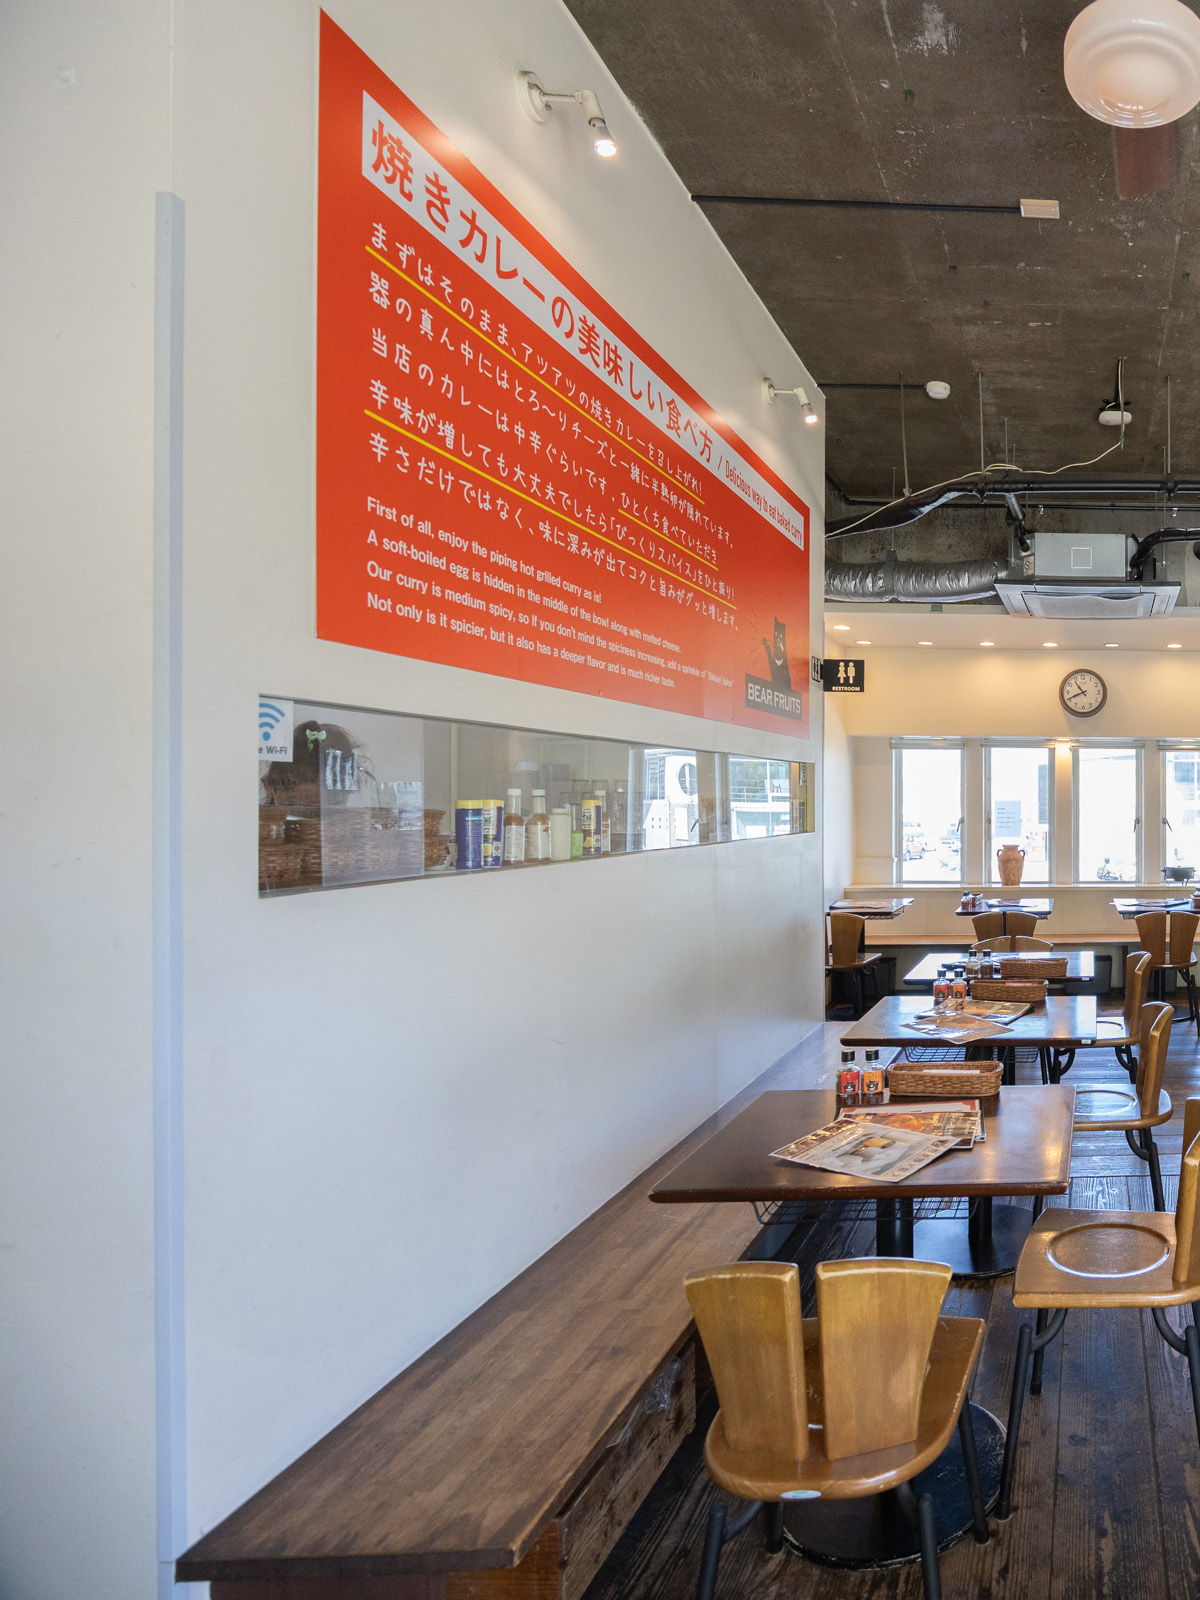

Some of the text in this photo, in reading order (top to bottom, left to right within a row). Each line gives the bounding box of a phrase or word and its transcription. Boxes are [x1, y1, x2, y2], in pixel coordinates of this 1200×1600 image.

[371, 117, 713, 464] 焼きカレーの美味しい食べ方
[725, 459, 751, 499] Delicious
[751, 488, 764, 512] way
[763, 495, 769, 513] to
[768, 505, 777, 520] eat
[776, 506, 791, 532] baked
[791, 524, 803, 547] curry
[367, 496, 602, 604] First of all, enjoy the piping hot grilled curry as is!
[367, 529, 681, 654] A soft-boiled egg is hidden in the middle of the bowl along with melted cheese.
[367, 560, 393, 582] Our
[396, 571, 429, 596] curry
[432, 581, 442, 598] is
[445, 586, 486, 612] medium
[489, 602, 516, 623] spicy,
[518, 612, 530, 625] so
[531, 614, 538, 628] If
[539, 617, 556, 633] you
[557, 621, 577, 640] don't
[577, 630, 595, 646] mind
[596, 635, 607, 649] the
[608, 640, 637, 658] spiciness
[637, 648, 666, 668] increasing,
[667, 660, 677, 670] add
[677, 663, 681, 671] a
[681, 664, 700, 677] sprinkle
[701, 669, 706, 678] of
[367, 591, 676, 689] Not only is it spicier, but it also has a deeper flavor and is much richer taste.
[266, 745, 288, 755] Wi-Fi
[747, 682, 801, 715] BEAR FRUITS
